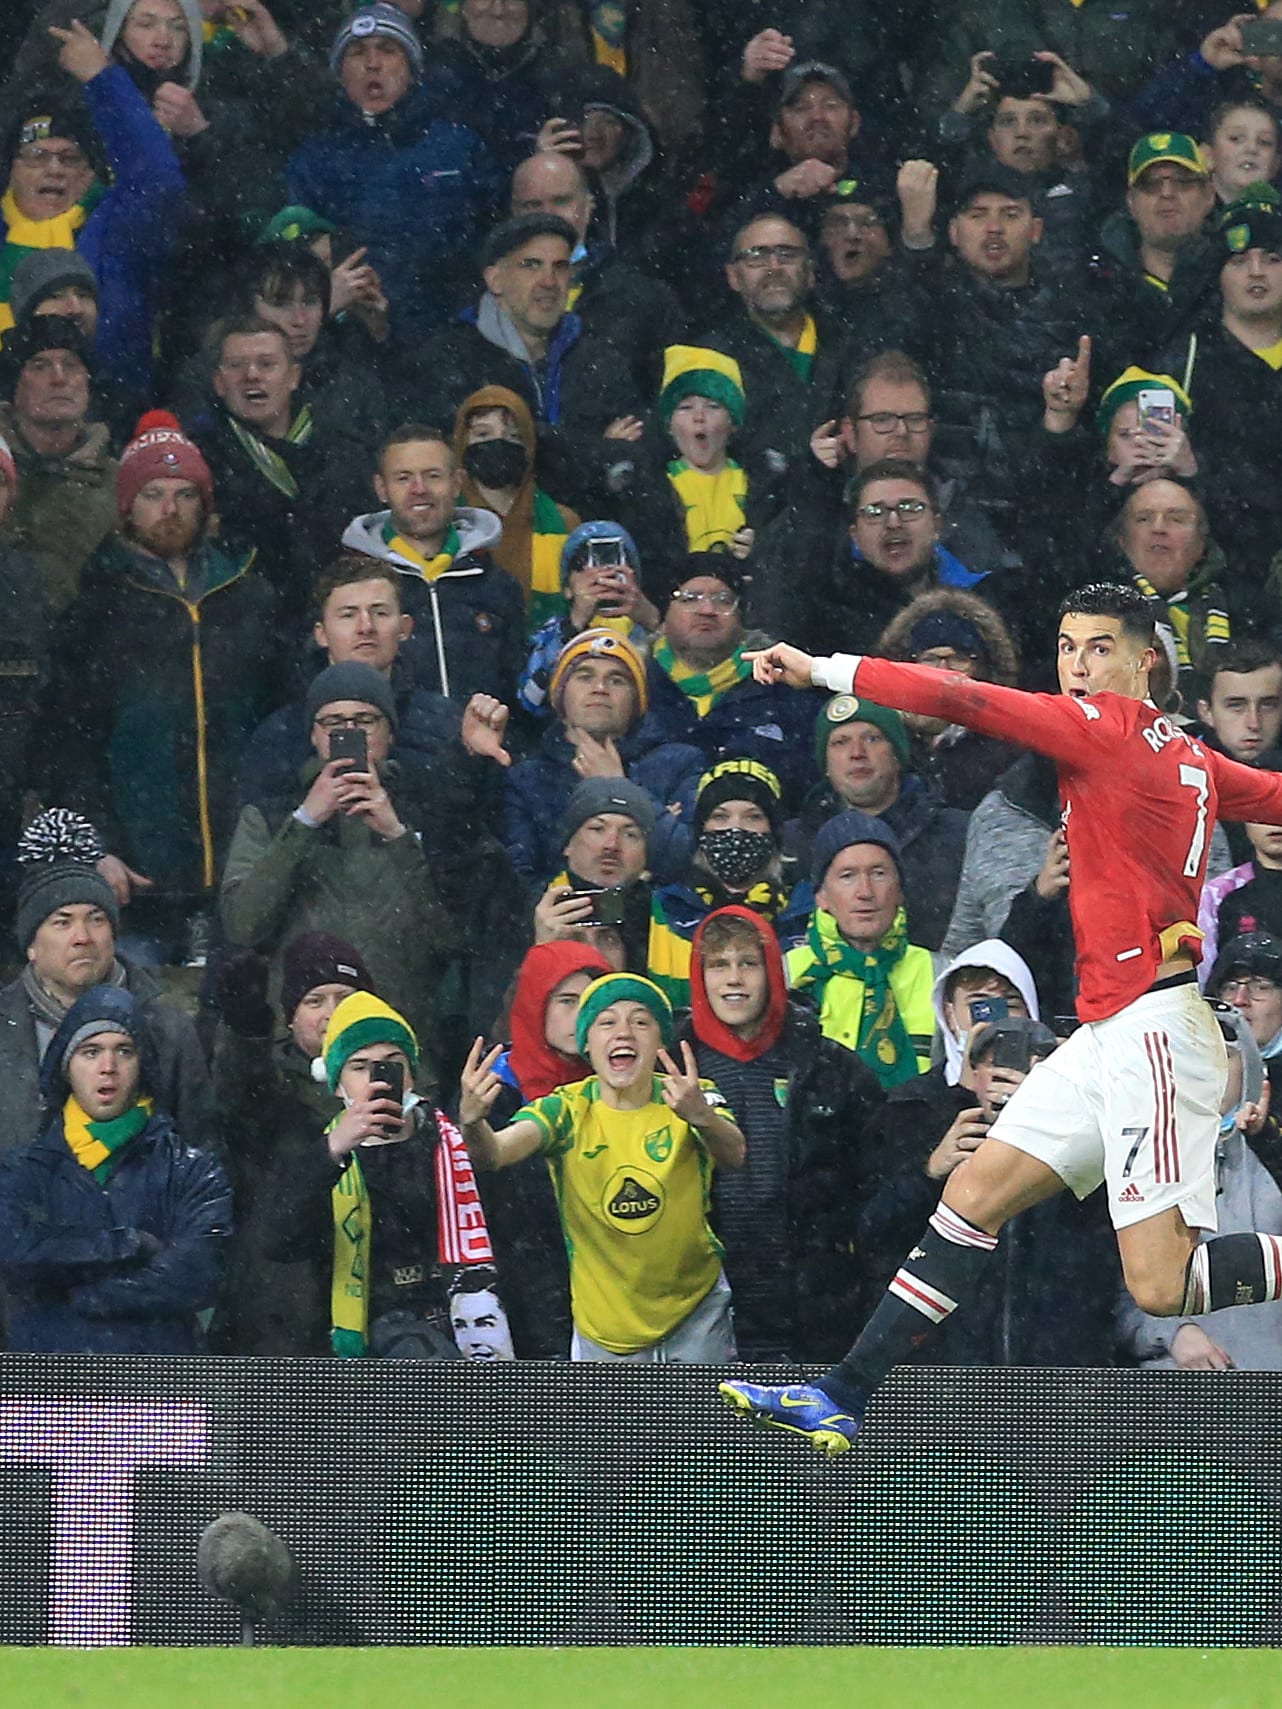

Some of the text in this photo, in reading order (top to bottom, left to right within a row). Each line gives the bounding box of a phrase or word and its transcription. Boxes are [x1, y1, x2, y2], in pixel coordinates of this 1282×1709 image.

[1177, 763, 1209, 878] 7
[1120, 1126, 1151, 1178] 7
[610, 1198, 658, 1215] LOTUS
[0, 1397, 213, 1647] T
